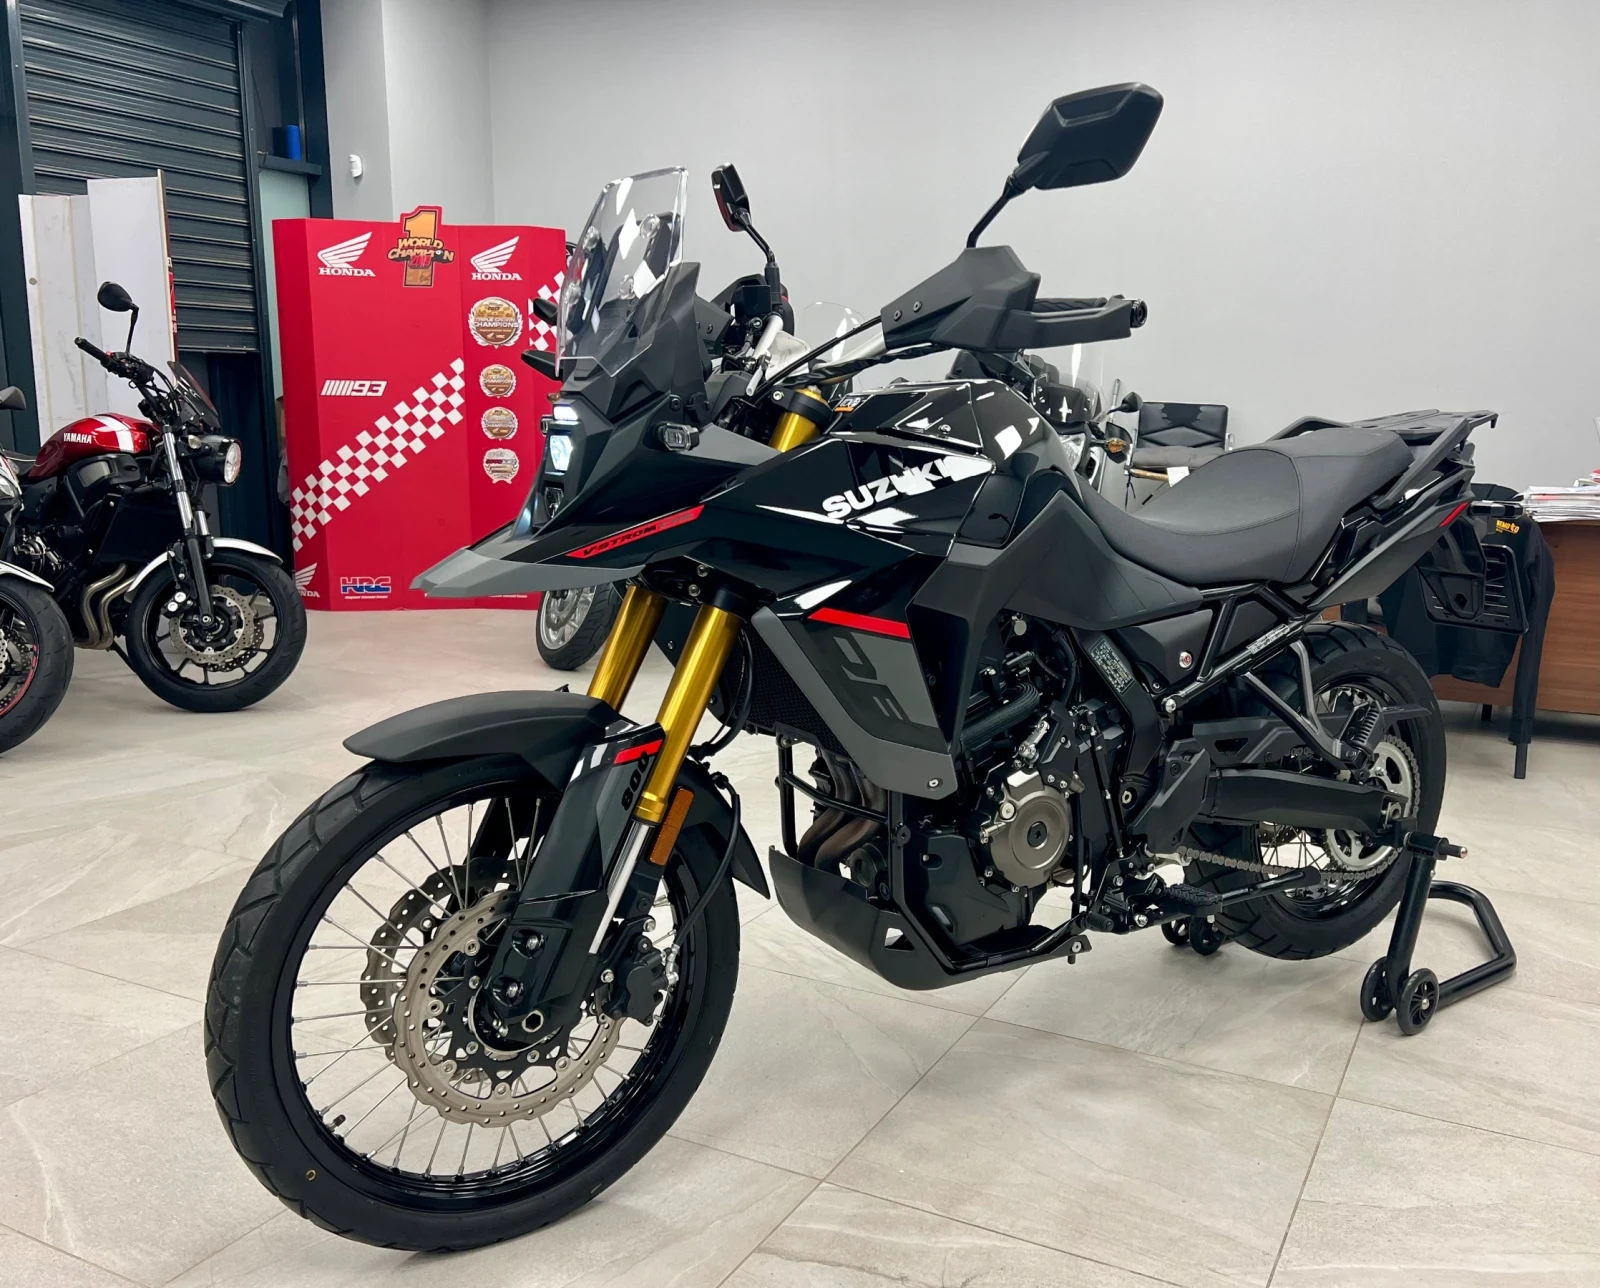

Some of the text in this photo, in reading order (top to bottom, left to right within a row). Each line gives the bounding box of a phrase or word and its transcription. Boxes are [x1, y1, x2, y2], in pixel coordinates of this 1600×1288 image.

[397, 237, 444, 249] WORLD
[318, 266, 377, 278] HONDA
[471, 272, 523, 282] HONDA
[63, 432, 93, 444] YAMAHA
[821, 457, 950, 519] SUZUKI
[340, 576, 392, 595] HRC
[621, 750, 650, 812] 800
